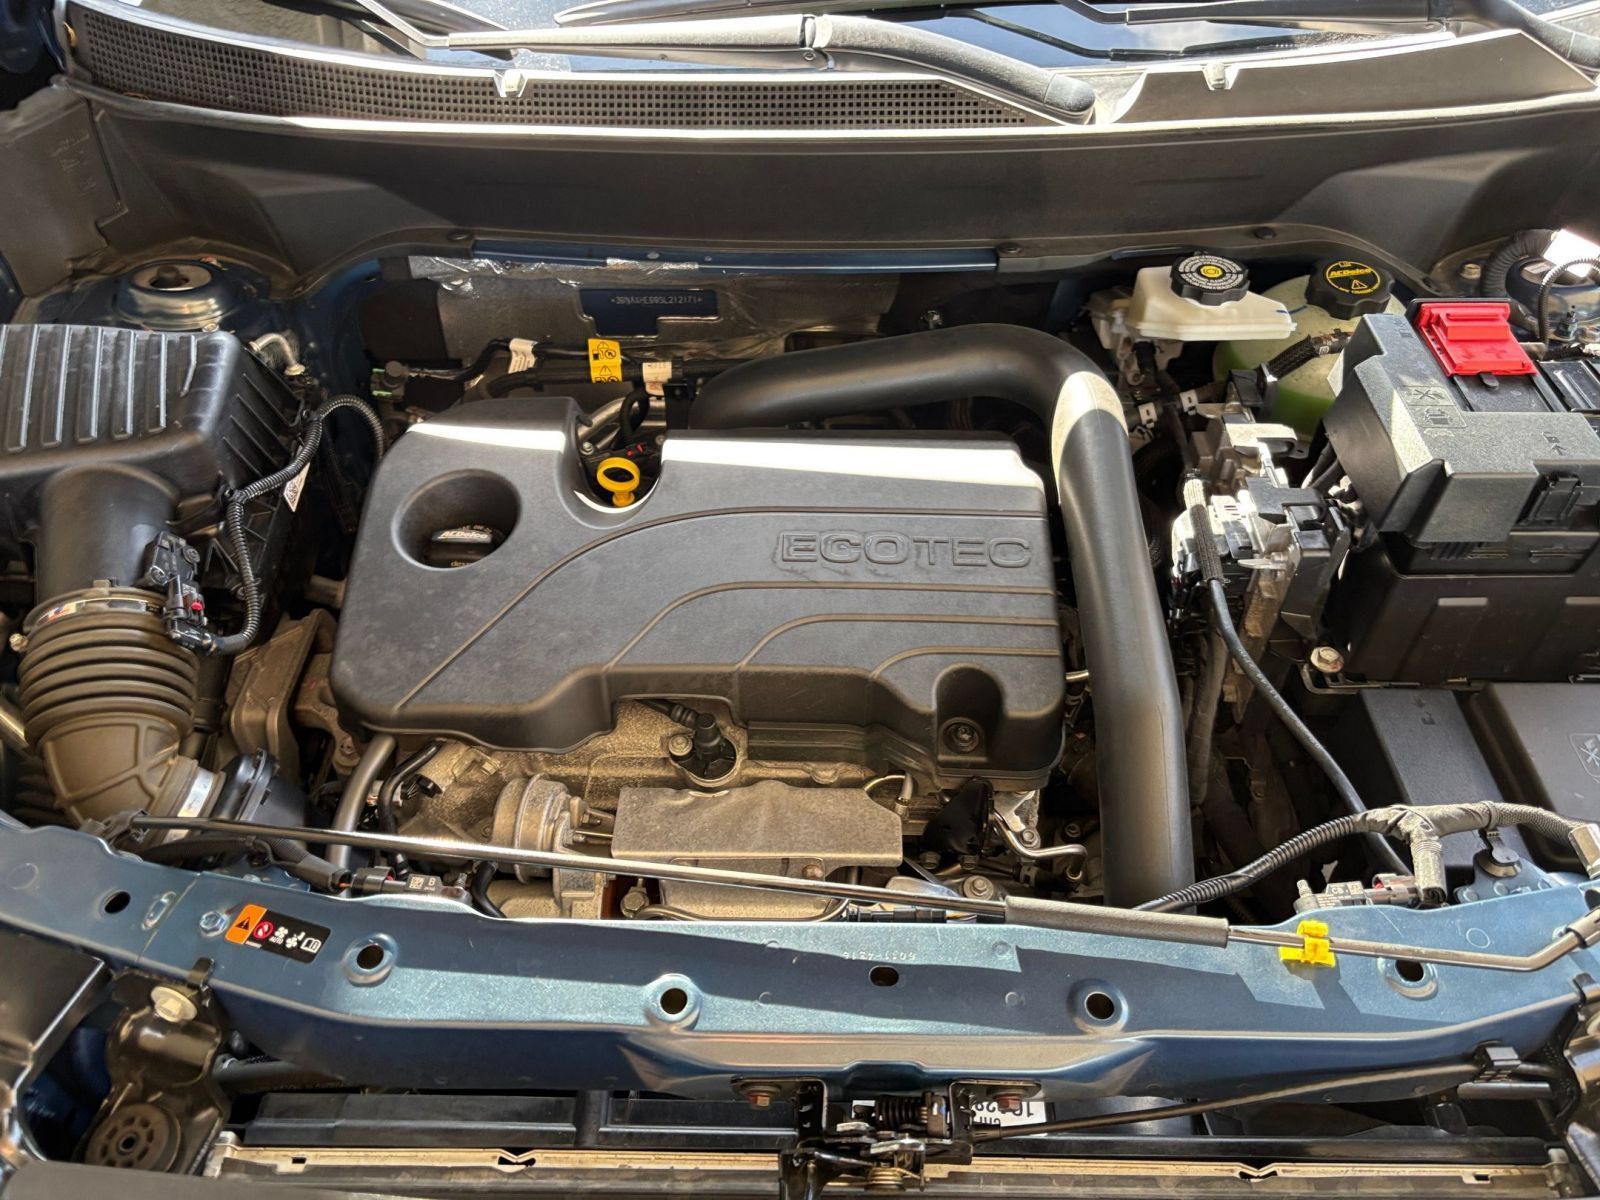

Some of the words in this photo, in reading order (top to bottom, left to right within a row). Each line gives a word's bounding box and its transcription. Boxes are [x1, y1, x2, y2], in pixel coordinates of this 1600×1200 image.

[1330, 267, 1372, 278] ACDelco
[439, 530, 489, 539] ACDelco
[777, 530, 1033, 569] ECOTEC
